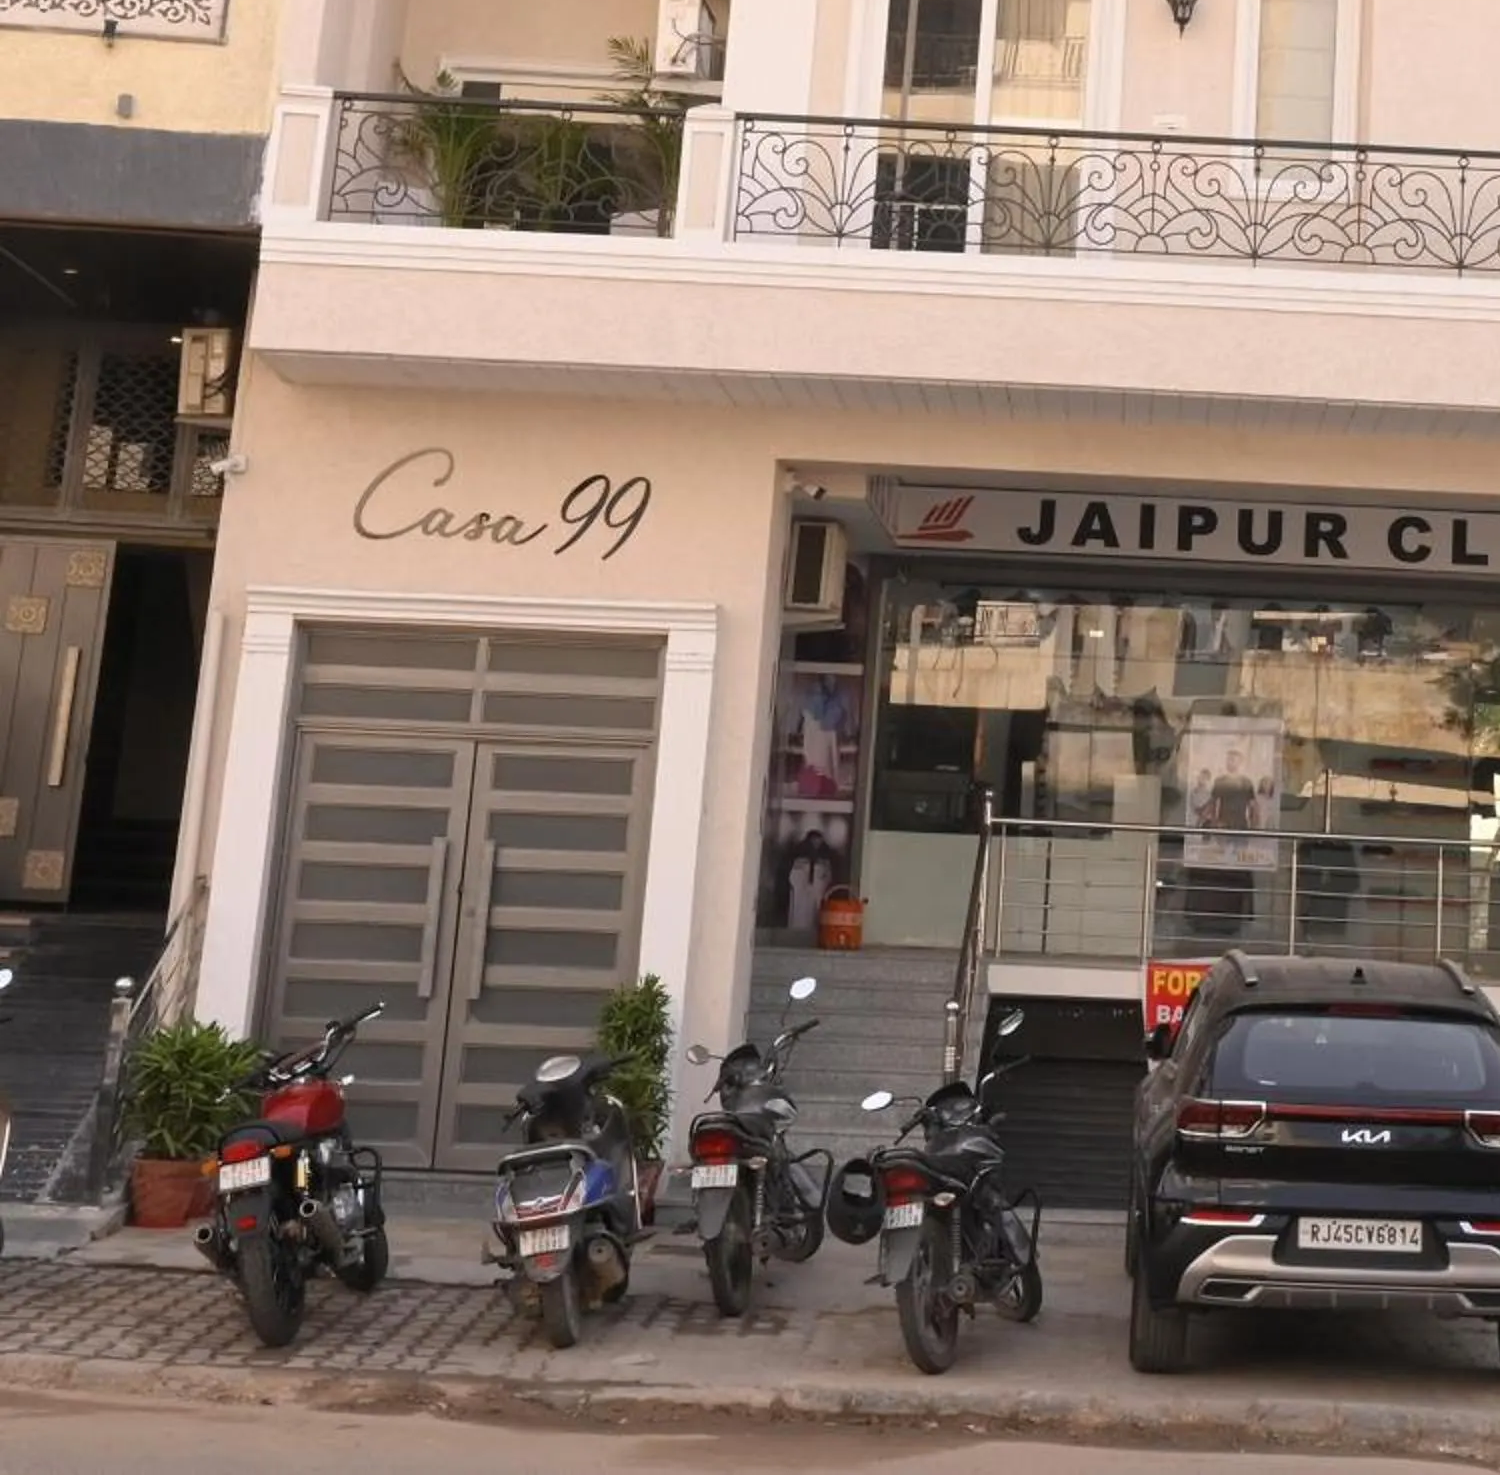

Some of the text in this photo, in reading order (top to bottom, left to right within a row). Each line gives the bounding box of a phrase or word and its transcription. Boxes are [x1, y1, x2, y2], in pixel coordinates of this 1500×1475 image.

[353, 447, 651, 560] Casa 99
[1017, 499, 1348, 559] JAIPUR
